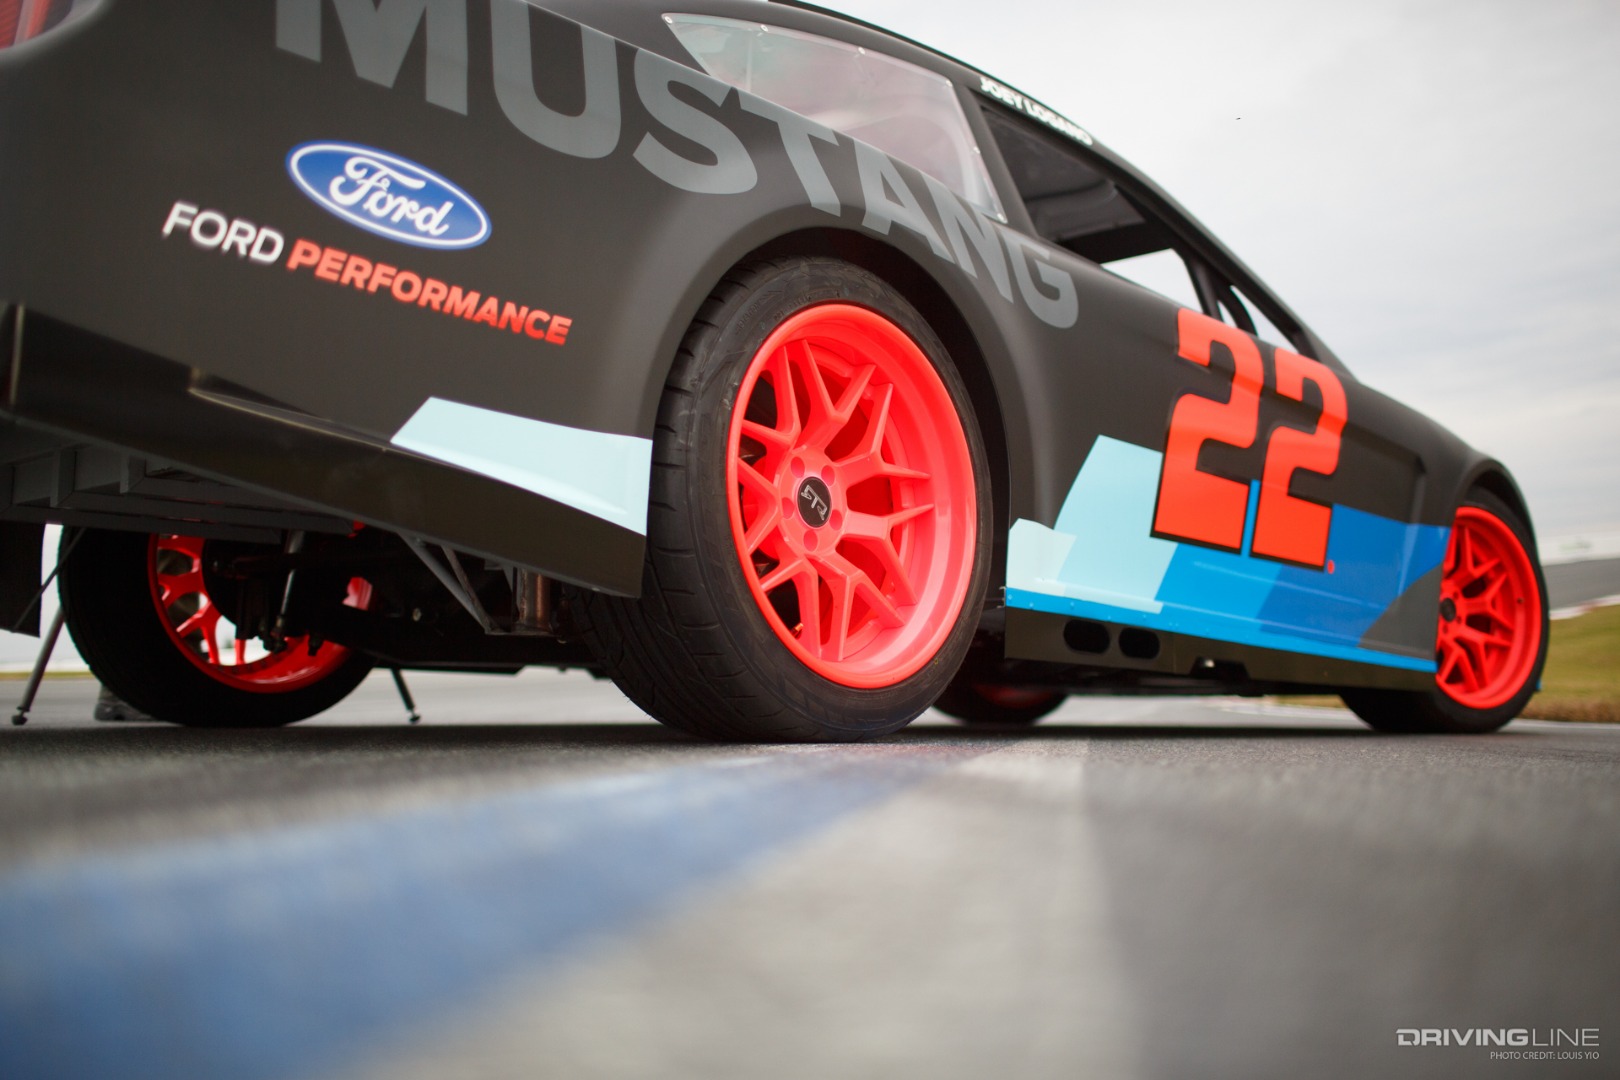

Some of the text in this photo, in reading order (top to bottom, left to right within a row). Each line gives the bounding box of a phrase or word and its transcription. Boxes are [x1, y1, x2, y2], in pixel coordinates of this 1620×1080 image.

[275, 0, 1080, 329] MUSTANG
[329, 156, 455, 237] Ford
[162, 201, 572, 346] FORD PERFORMANCE
[1153, 307, 1349, 571] 22
